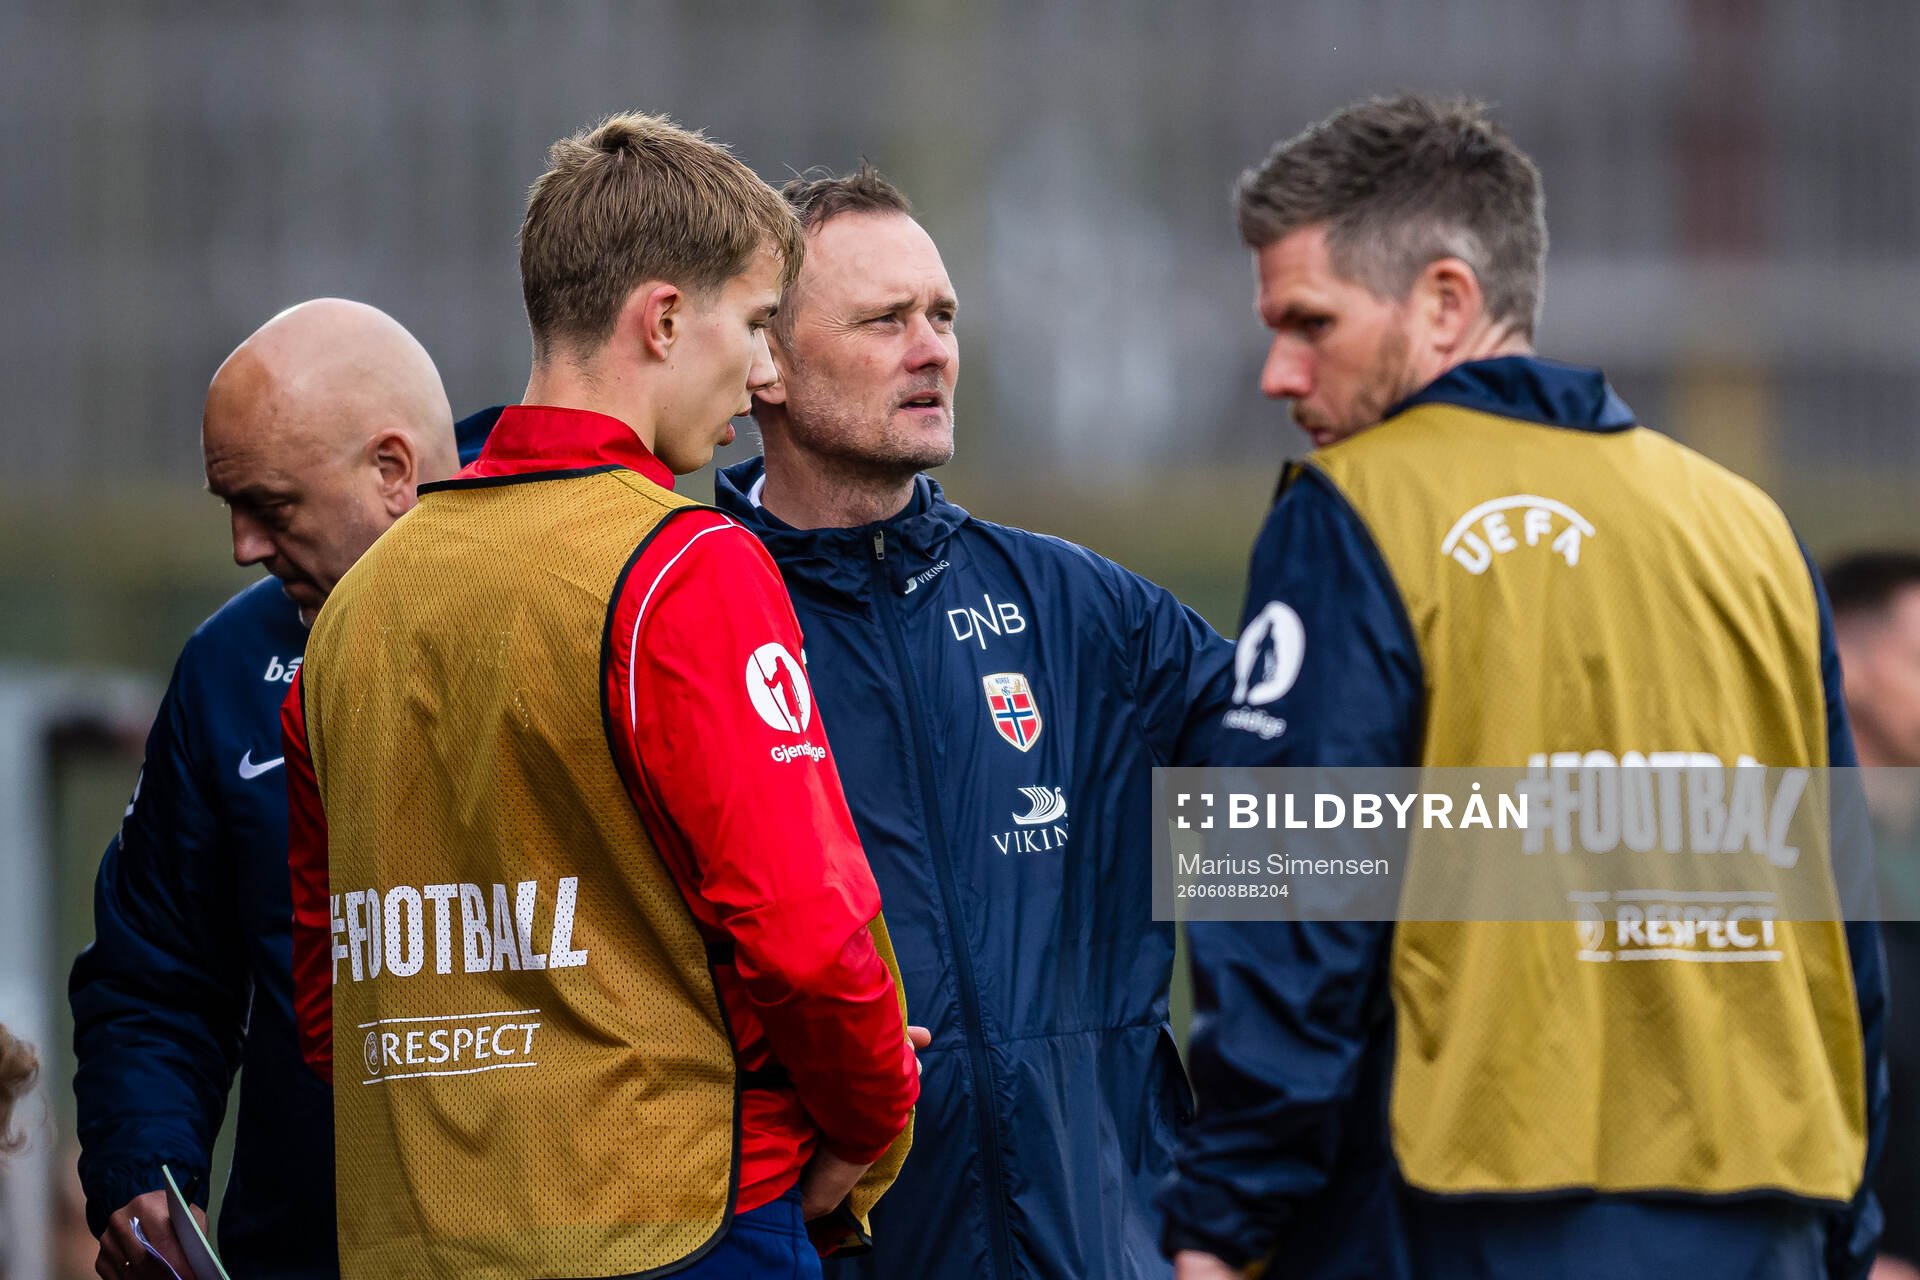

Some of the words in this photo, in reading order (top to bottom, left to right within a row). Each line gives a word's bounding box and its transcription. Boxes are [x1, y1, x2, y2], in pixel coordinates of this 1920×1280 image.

[1452, 508, 1582, 575] UEFA
[917, 559, 950, 584] VIKING
[947, 594, 1026, 650] DNB
[330, 877, 588, 984] #FOOTBALL
[1615, 905, 1779, 949] RESPECT
[381, 1023, 541, 1067] RESPECT
